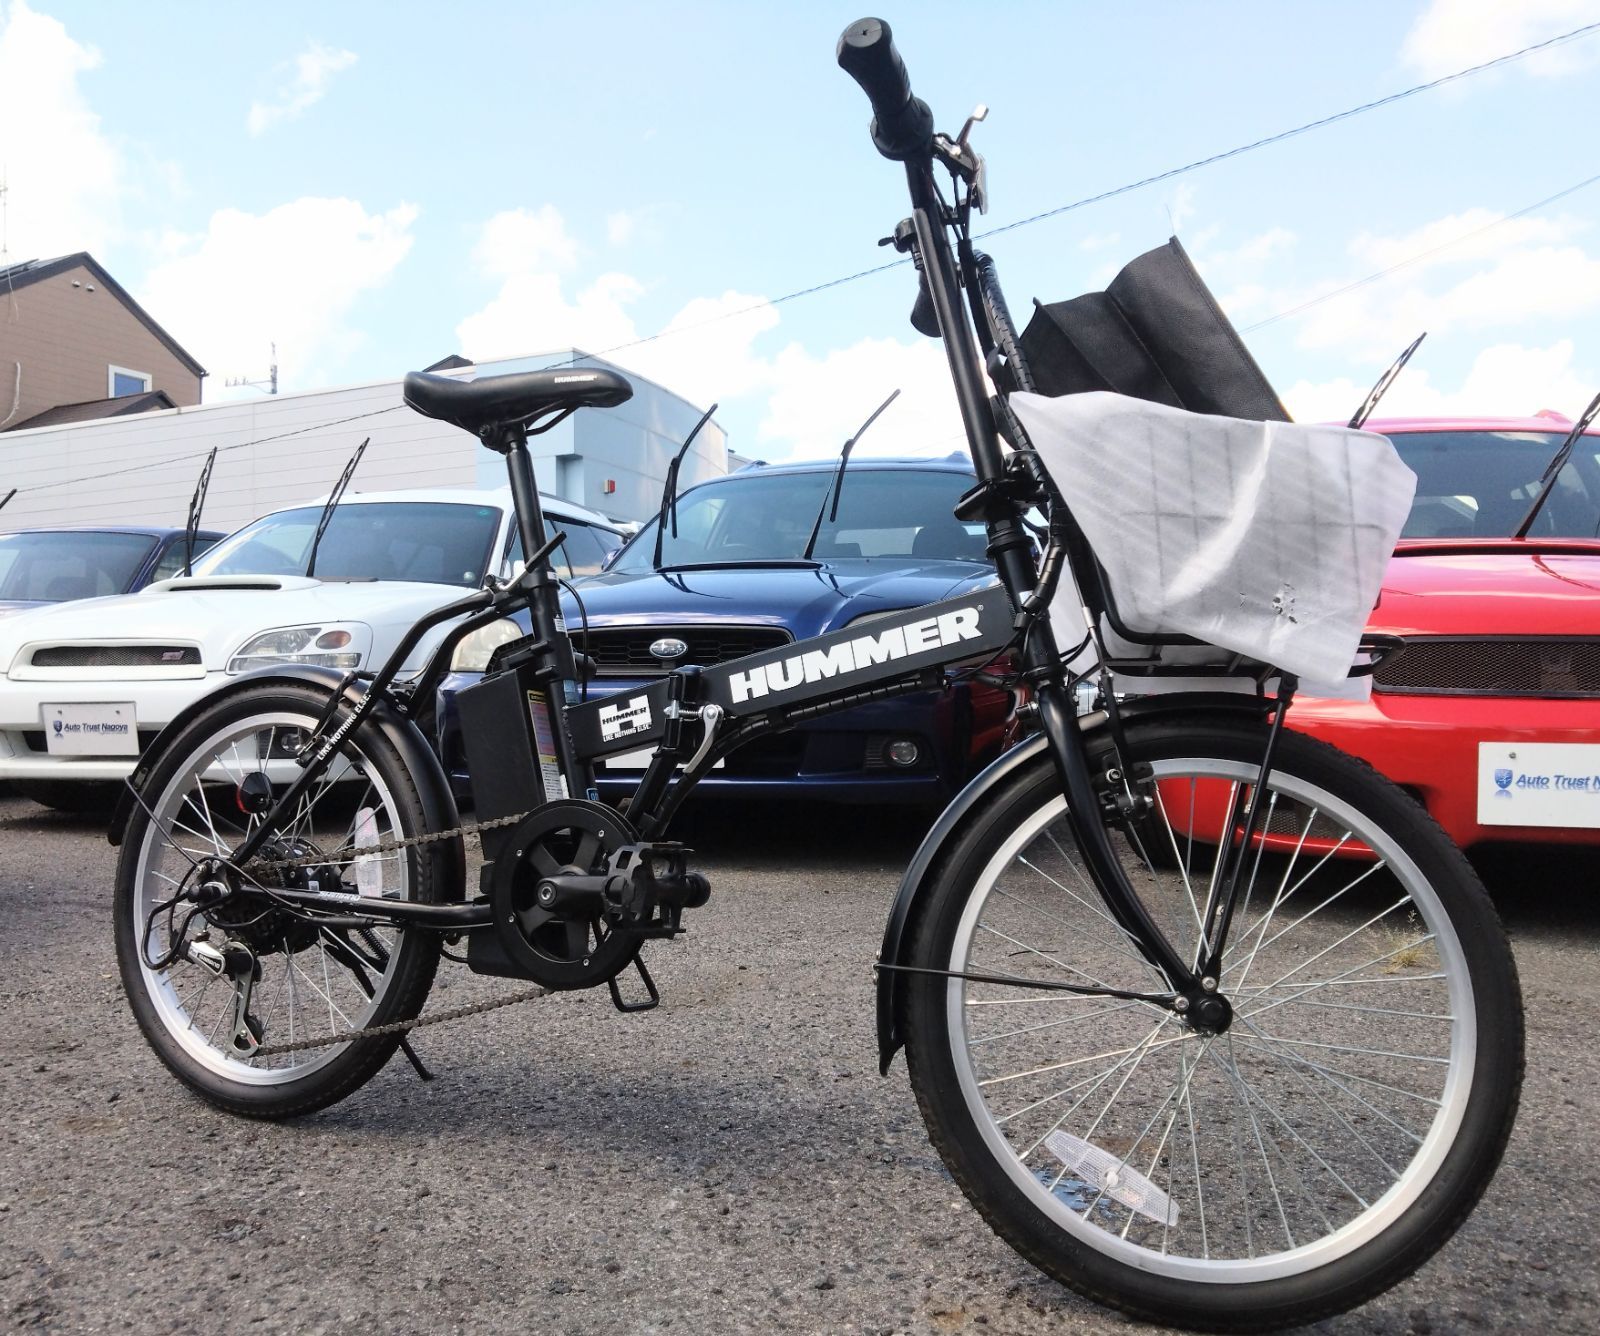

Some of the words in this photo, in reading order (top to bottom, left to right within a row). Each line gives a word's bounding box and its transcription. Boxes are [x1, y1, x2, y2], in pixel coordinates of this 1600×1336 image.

[602, 707, 647, 724] HUMMER
[64, 723, 81, 731] Auto
[82, 723, 100, 731] Trust
[101, 723, 128, 733] Nagoya
[603, 733, 615, 742] LIKE
[614, 727, 637, 739] NOTHING
[317, 744, 333, 760] LIKE
[331, 712, 357, 745] NOTHING
[1516, 774, 1550, 786] Auto
[1554, 775, 1591, 787] Trust
